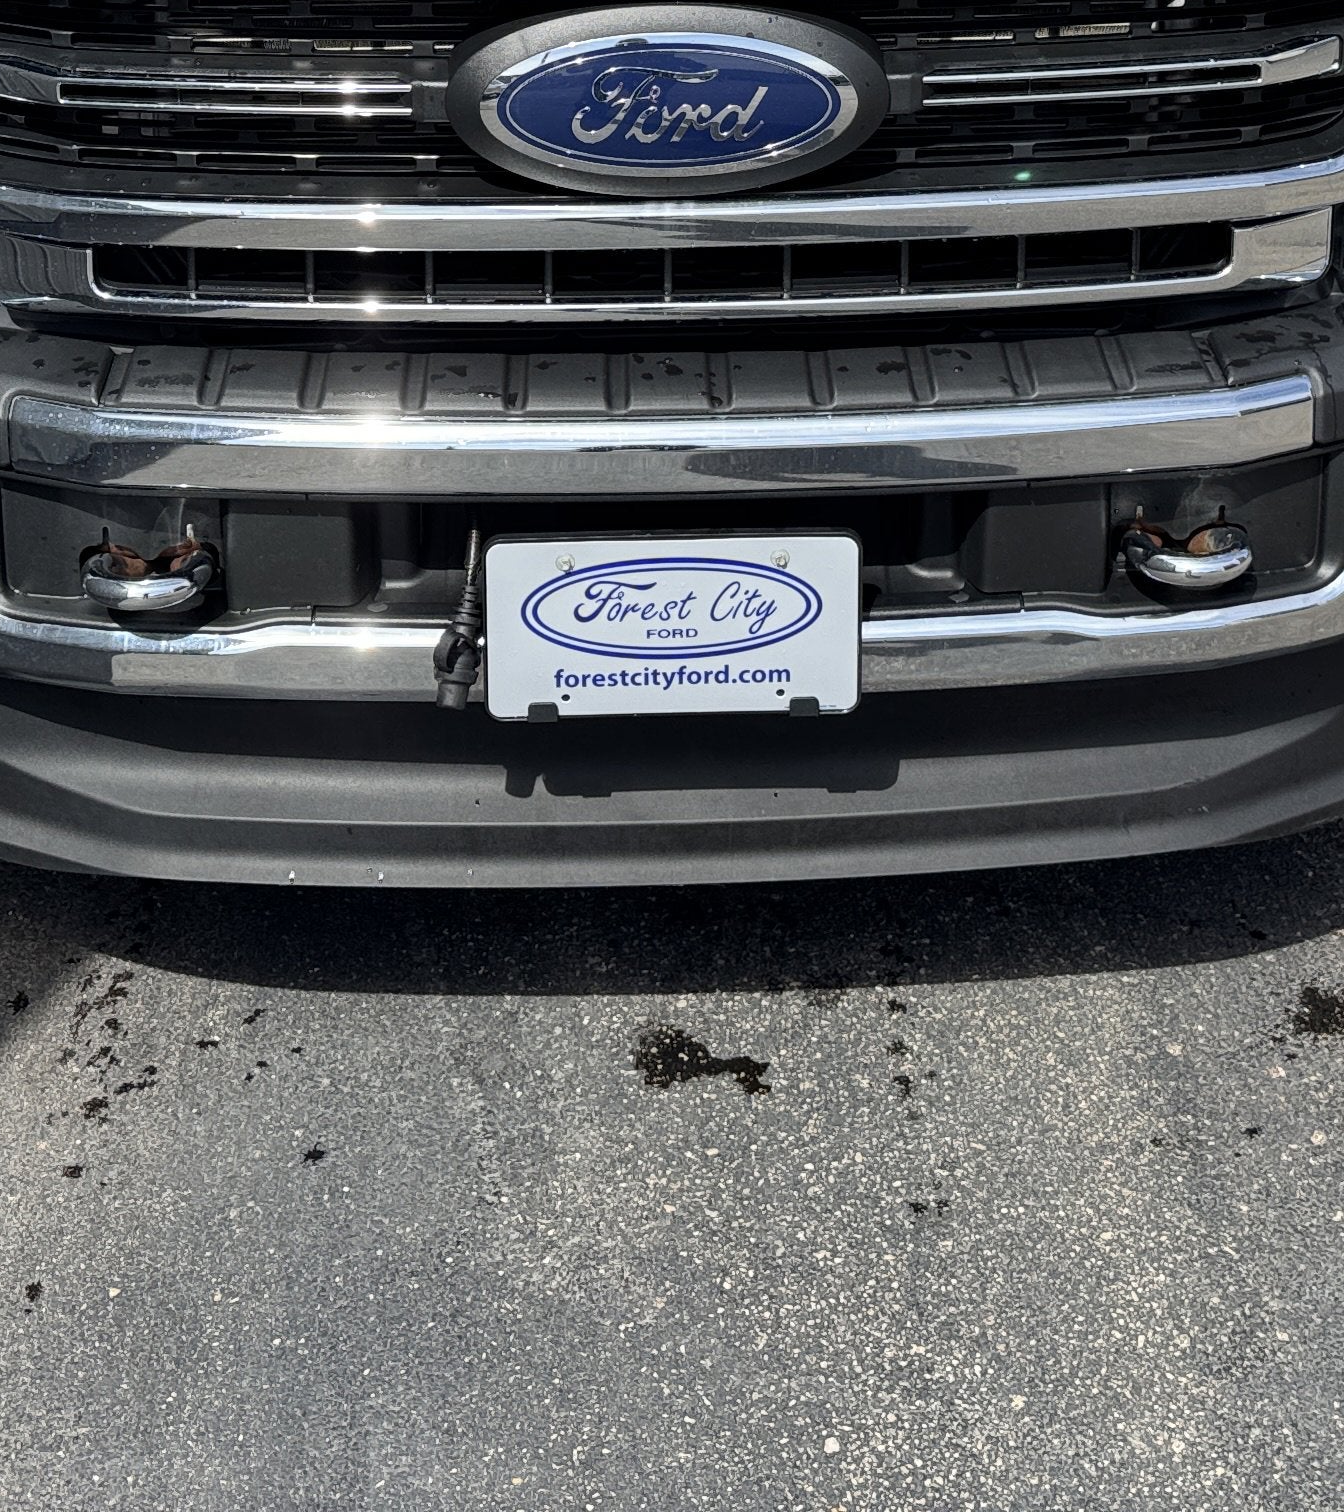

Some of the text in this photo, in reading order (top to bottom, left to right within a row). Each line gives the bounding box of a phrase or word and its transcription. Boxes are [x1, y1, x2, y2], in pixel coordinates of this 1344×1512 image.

[571, 65, 765, 144] Ford
[573, 580, 778, 635] Forest City
[646, 628, 698, 639] FORD
[554, 664, 792, 690] forestcityford.com
